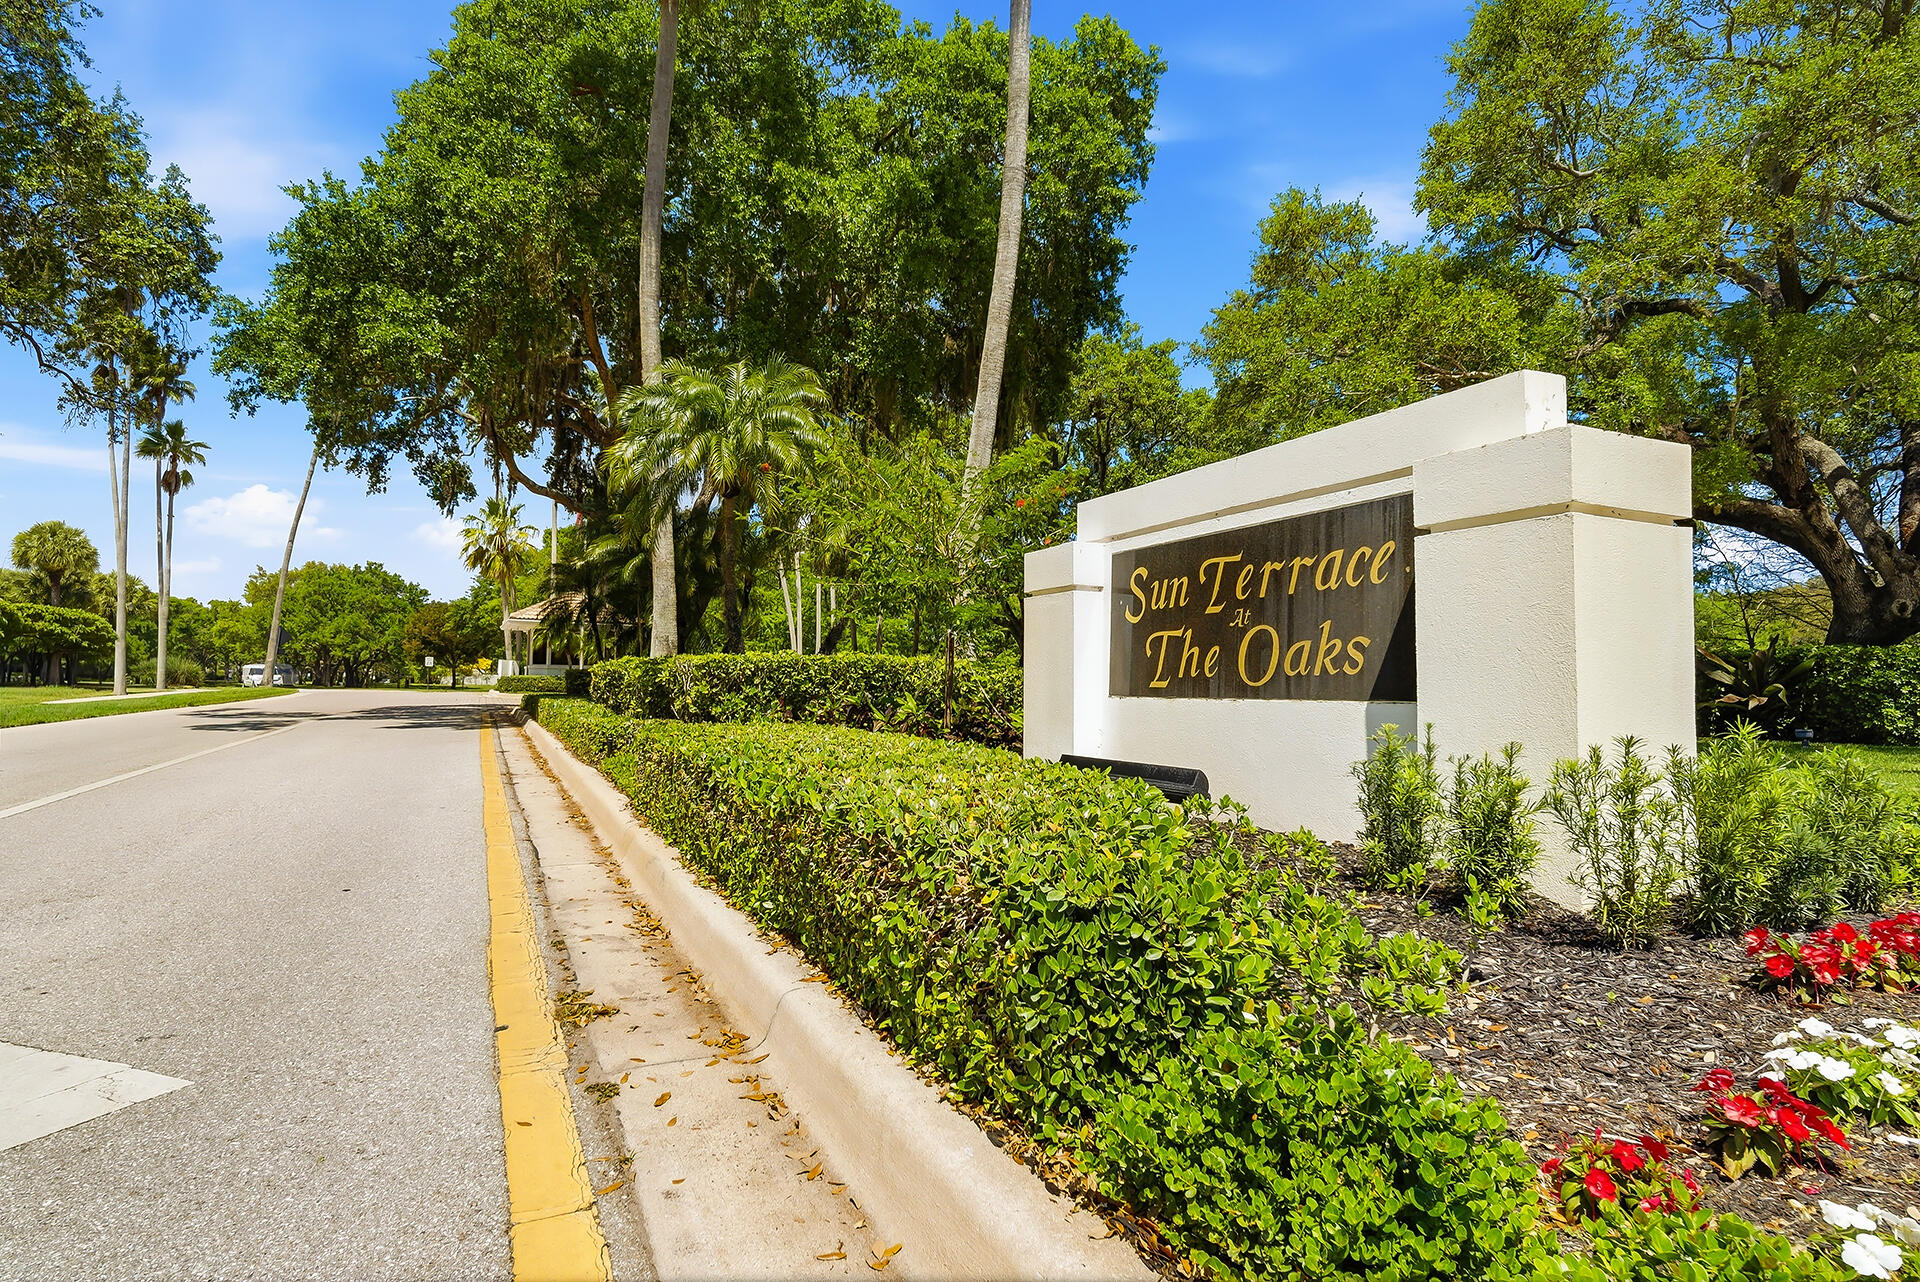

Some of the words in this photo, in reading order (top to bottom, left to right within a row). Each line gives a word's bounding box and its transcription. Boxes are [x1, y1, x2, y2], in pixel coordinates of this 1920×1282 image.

[1125, 567, 1189, 623] Sun
[1200, 540, 1396, 614] Terrace
[1229, 608, 1251, 627] At
[1145, 625, 1220, 688] The
[1238, 620, 1371, 687] Oaks
